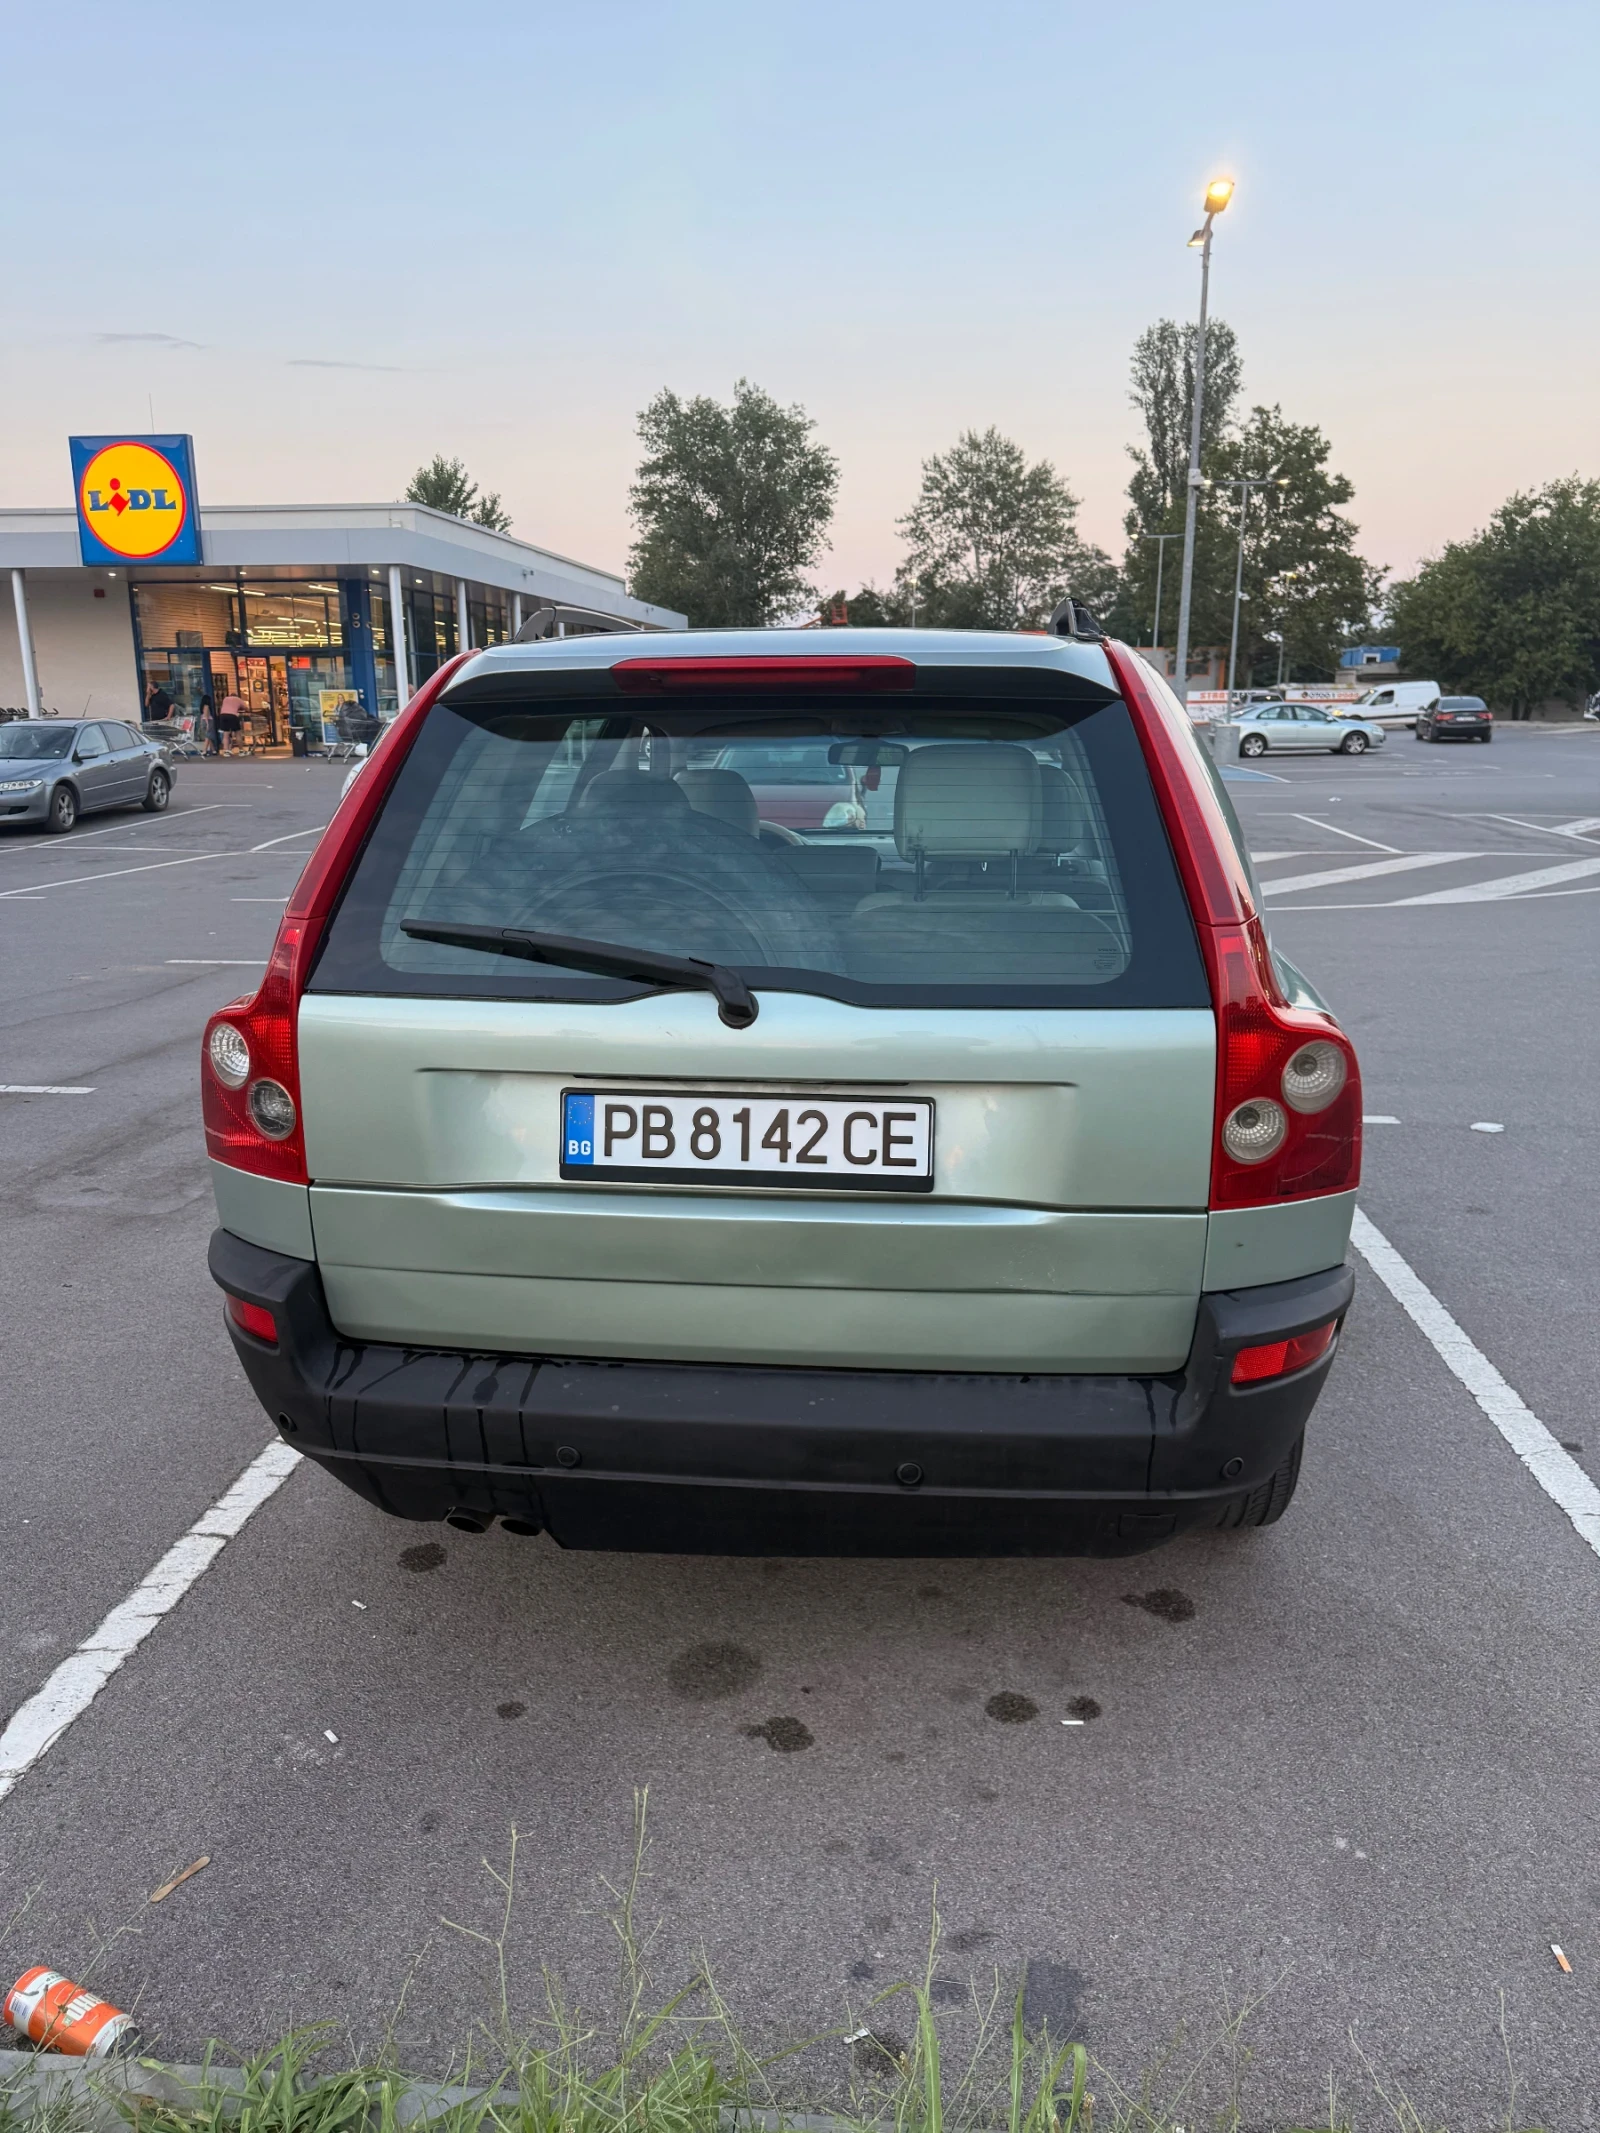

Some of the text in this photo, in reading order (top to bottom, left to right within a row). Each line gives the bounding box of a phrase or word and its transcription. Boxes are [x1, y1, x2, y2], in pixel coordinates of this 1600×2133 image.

[568, 1140, 592, 1156] BG
[604, 1103, 917, 1167] PB 8142 CE
